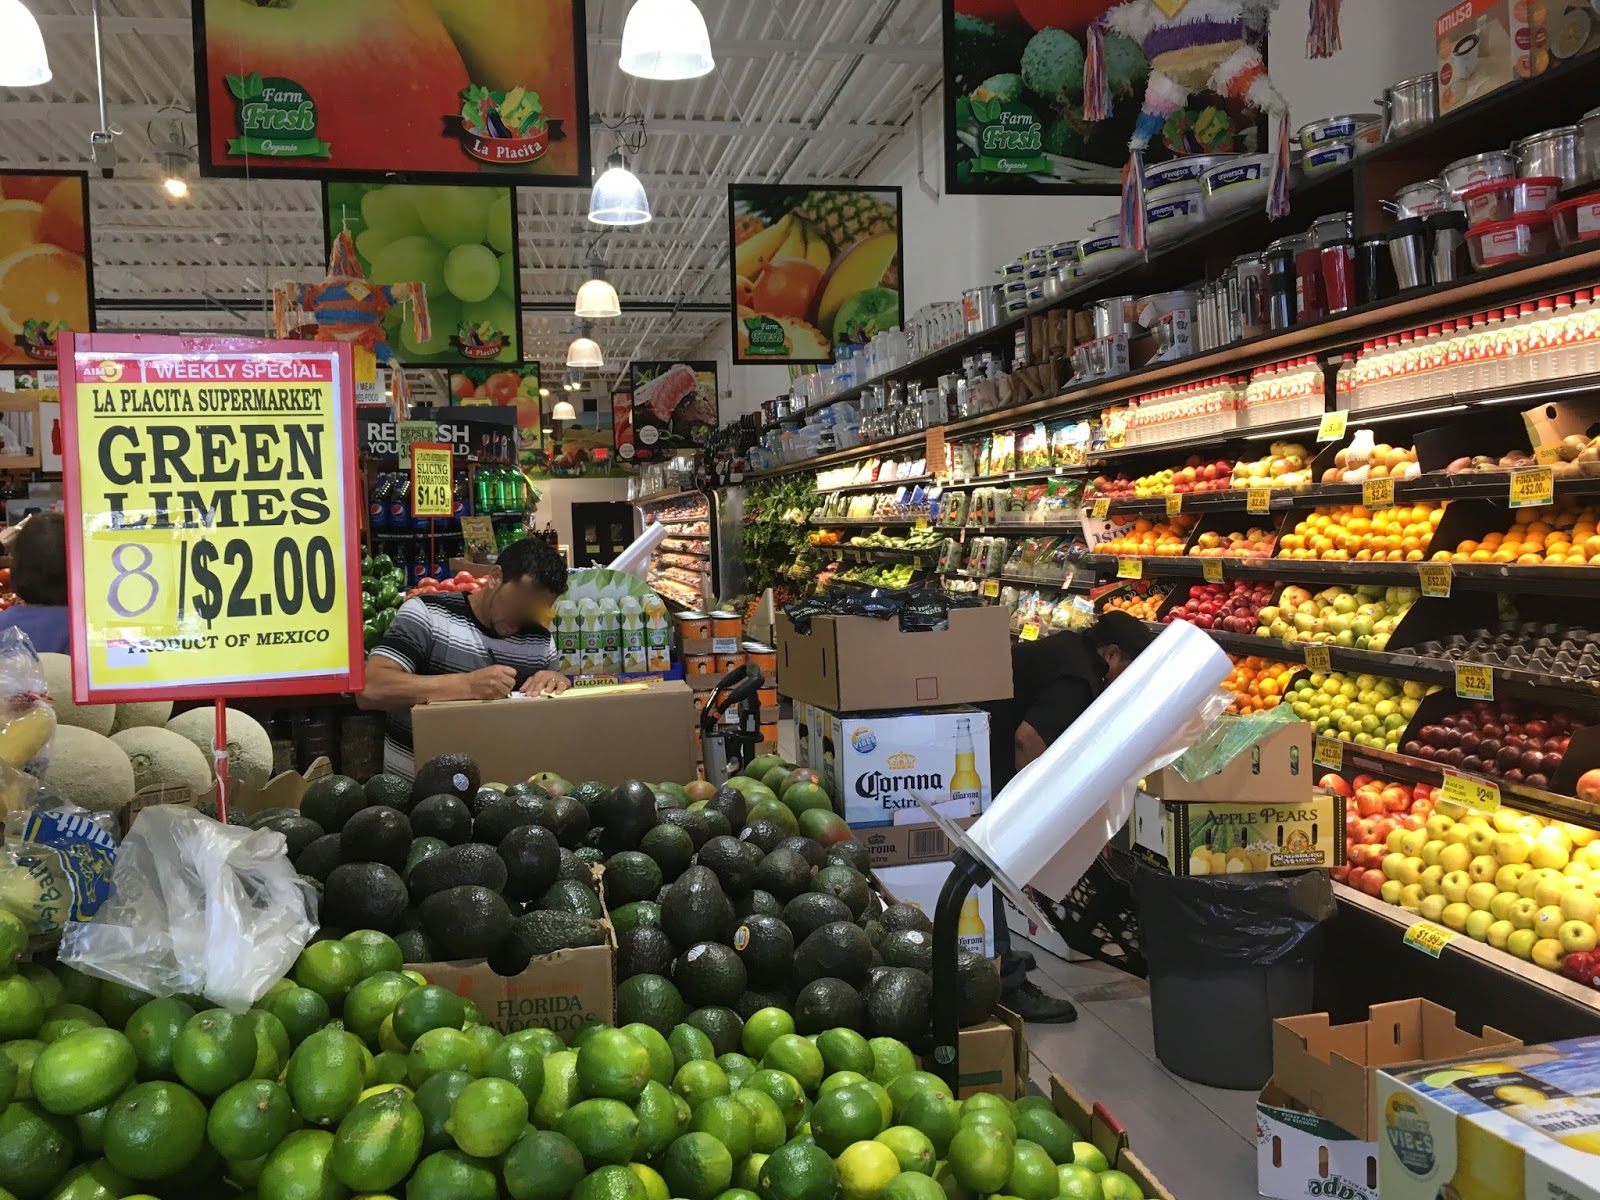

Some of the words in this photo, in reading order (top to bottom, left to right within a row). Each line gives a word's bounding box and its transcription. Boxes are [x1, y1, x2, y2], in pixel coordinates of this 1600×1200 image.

[262, 87, 303, 103] Farm
[242, 101, 315, 131] Fresh
[1000, 111, 1033, 126] Farm
[982, 122, 1042, 150] Fresh
[260, 139, 298, 154] Organic
[472, 139, 489, 155] La
[496, 141, 543, 159] Placita
[997, 159, 1028, 171] Organic
[760, 323, 779, 331] Farm
[751, 329, 784, 343] Fresh
[465, 346, 473, 354] La
[476, 347, 500, 357] Placita
[156, 363, 237, 380] WEEKLY
[241, 362, 323, 379] SPECIAL
[93, 389, 117, 413] LA
[120, 388, 195, 413] PLACITA
[198, 387, 323, 412] SUPERMARKET
[367, 422, 470, 443] RESH
[400, 428, 426, 439] PEPSI
[98, 423, 325, 486] GREEN
[368, 441, 399, 454] YOU
[416, 463, 448, 475] SLICING
[417, 474, 449, 485] TOMATOES
[418, 485, 446, 506] $1.19
[104, 487, 331, 530] LIMES
[107, 542, 160, 618] 8
[127, 634, 219, 654] PRODUCT
[225, 633, 251, 647] OF
[256, 629, 330, 646] MEXICO
[575, 678, 615, 687] GLORIA
[1465, 676, 1486, 690] $2.29
[852, 736, 877, 749] VIBES
[855, 770, 944, 801] Corona
[952, 790, 980, 801] Corona
[1204, 810, 1257, 826] APPLE
[1260, 808, 1318, 824] PEARS
[866, 844, 898, 854] orona
[870, 855, 888, 863] xtra
[1416, 929, 1441, 945] $1.99
[496, 994, 583, 1018] FLORIDA
